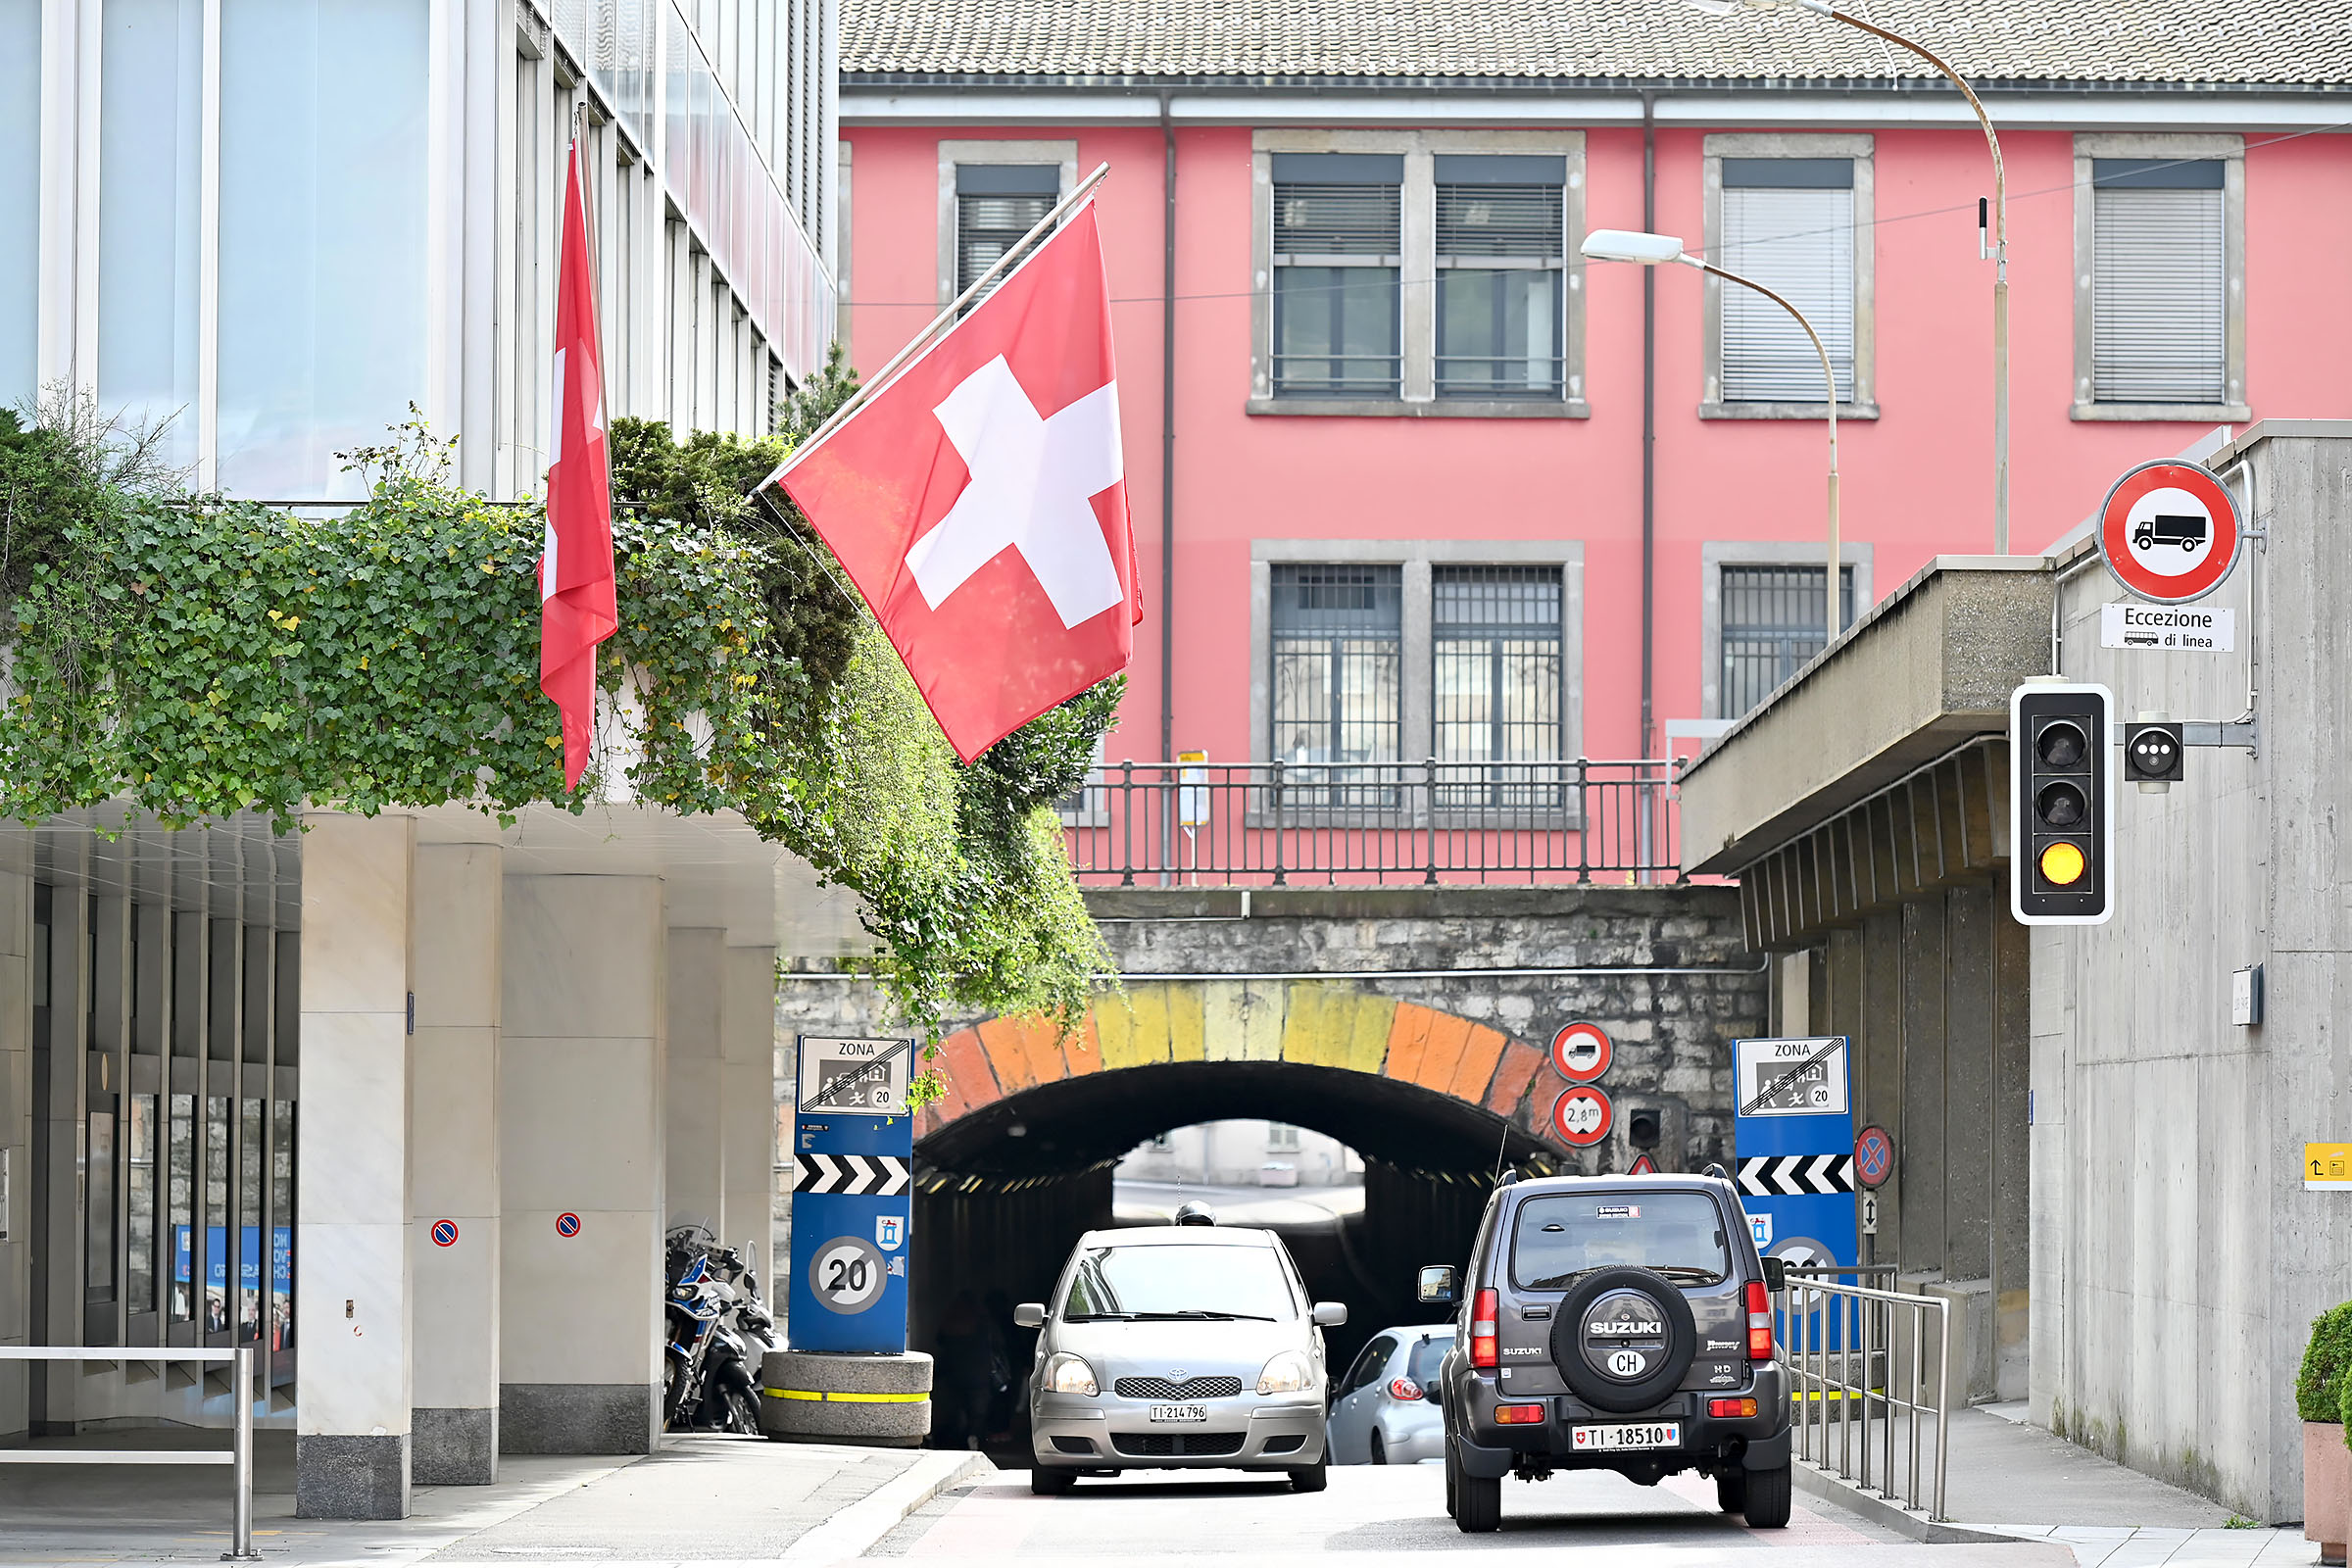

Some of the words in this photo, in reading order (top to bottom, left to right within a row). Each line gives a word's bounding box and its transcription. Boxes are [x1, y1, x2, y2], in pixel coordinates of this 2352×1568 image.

[2125, 608, 2212, 628] Eccezione
[2164, 633, 2177, 646] di
[2182, 634, 2213, 648] linea
[839, 1043, 875, 1055] ZONA
[1775, 1044, 1811, 1056] ZONA
[876, 1091, 890, 1103] 20
[1814, 1090, 1828, 1102] 20
[828, 1258, 866, 1292] 20
[1590, 1322, 1662, 1334] SUZUKI
[1617, 1354, 1637, 1372] CH
